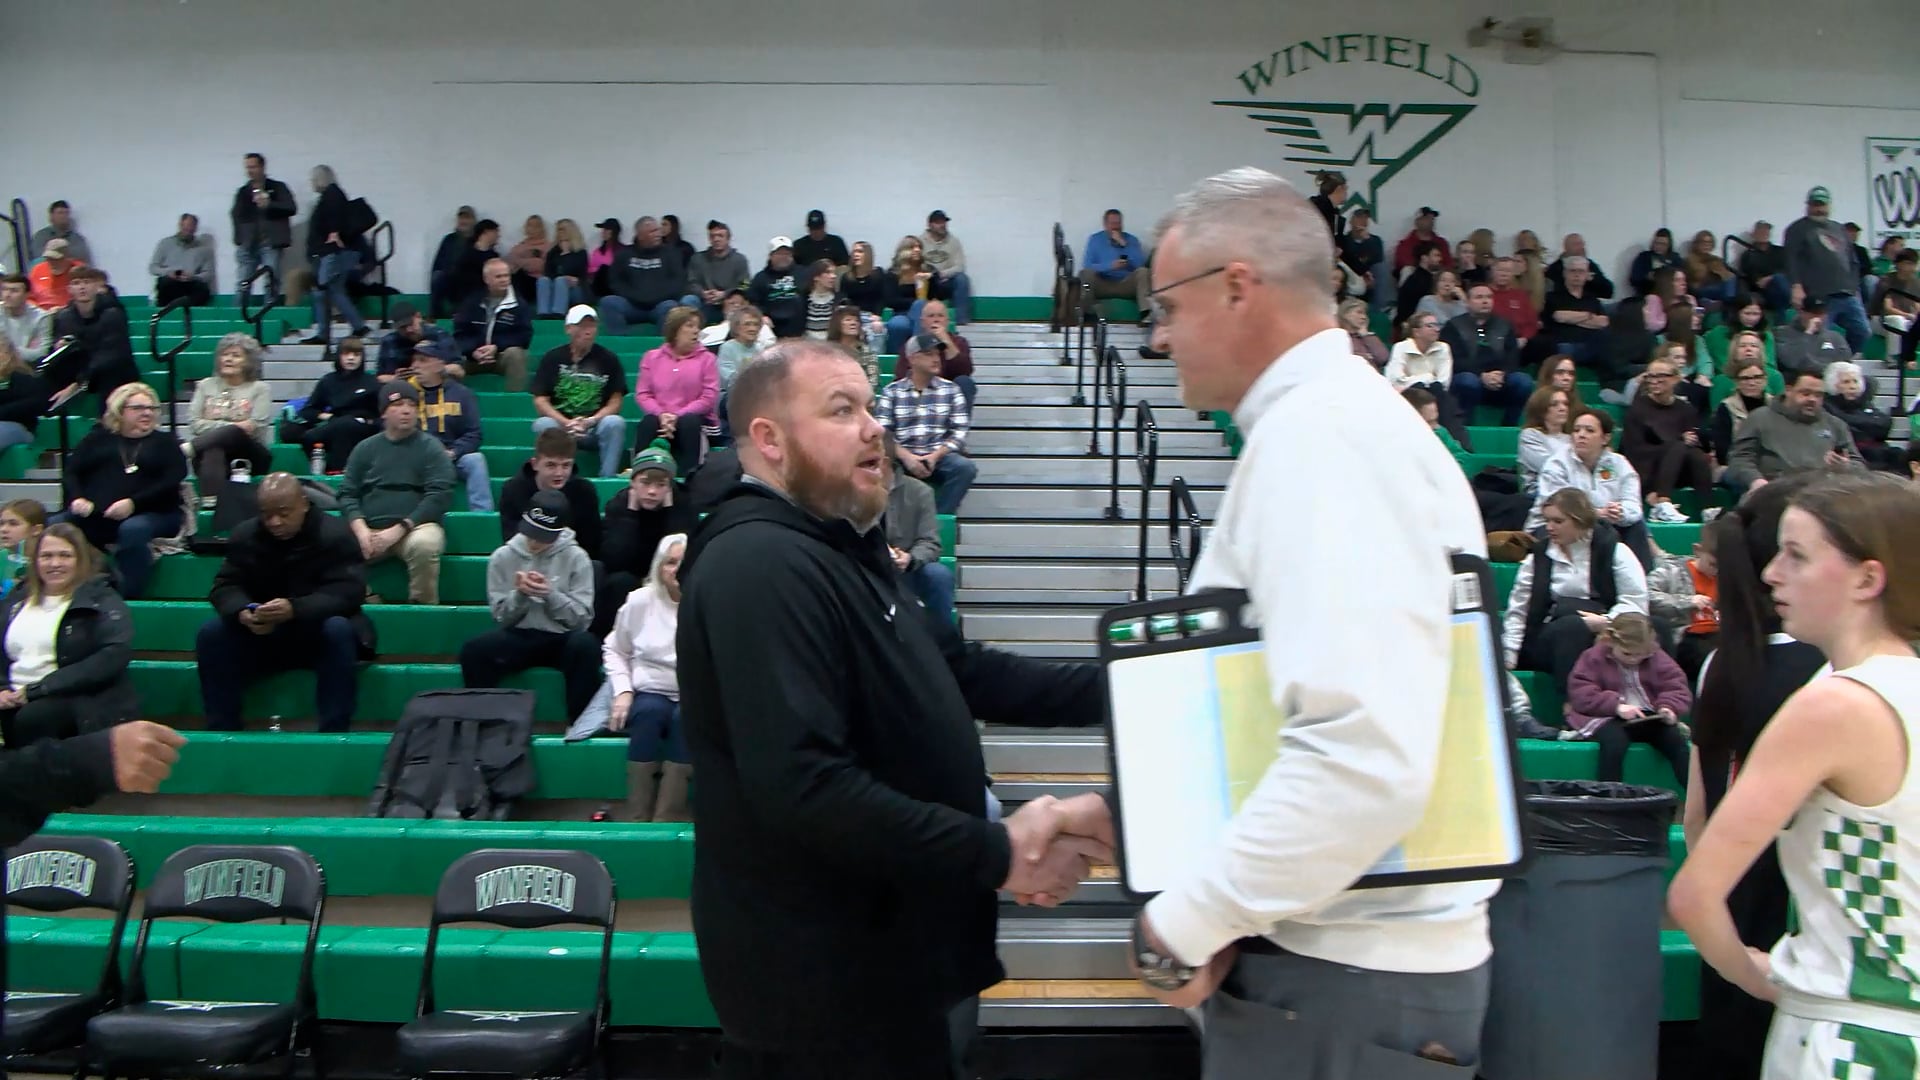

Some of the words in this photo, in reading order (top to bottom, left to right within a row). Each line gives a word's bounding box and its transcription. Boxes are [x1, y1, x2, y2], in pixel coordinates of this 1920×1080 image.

[1236, 34, 1479, 97] WINFIELD
[7, 850, 96, 897] WINFIELD
[184, 858, 286, 907] WINFIELD
[475, 864, 576, 912] WINFIELD
